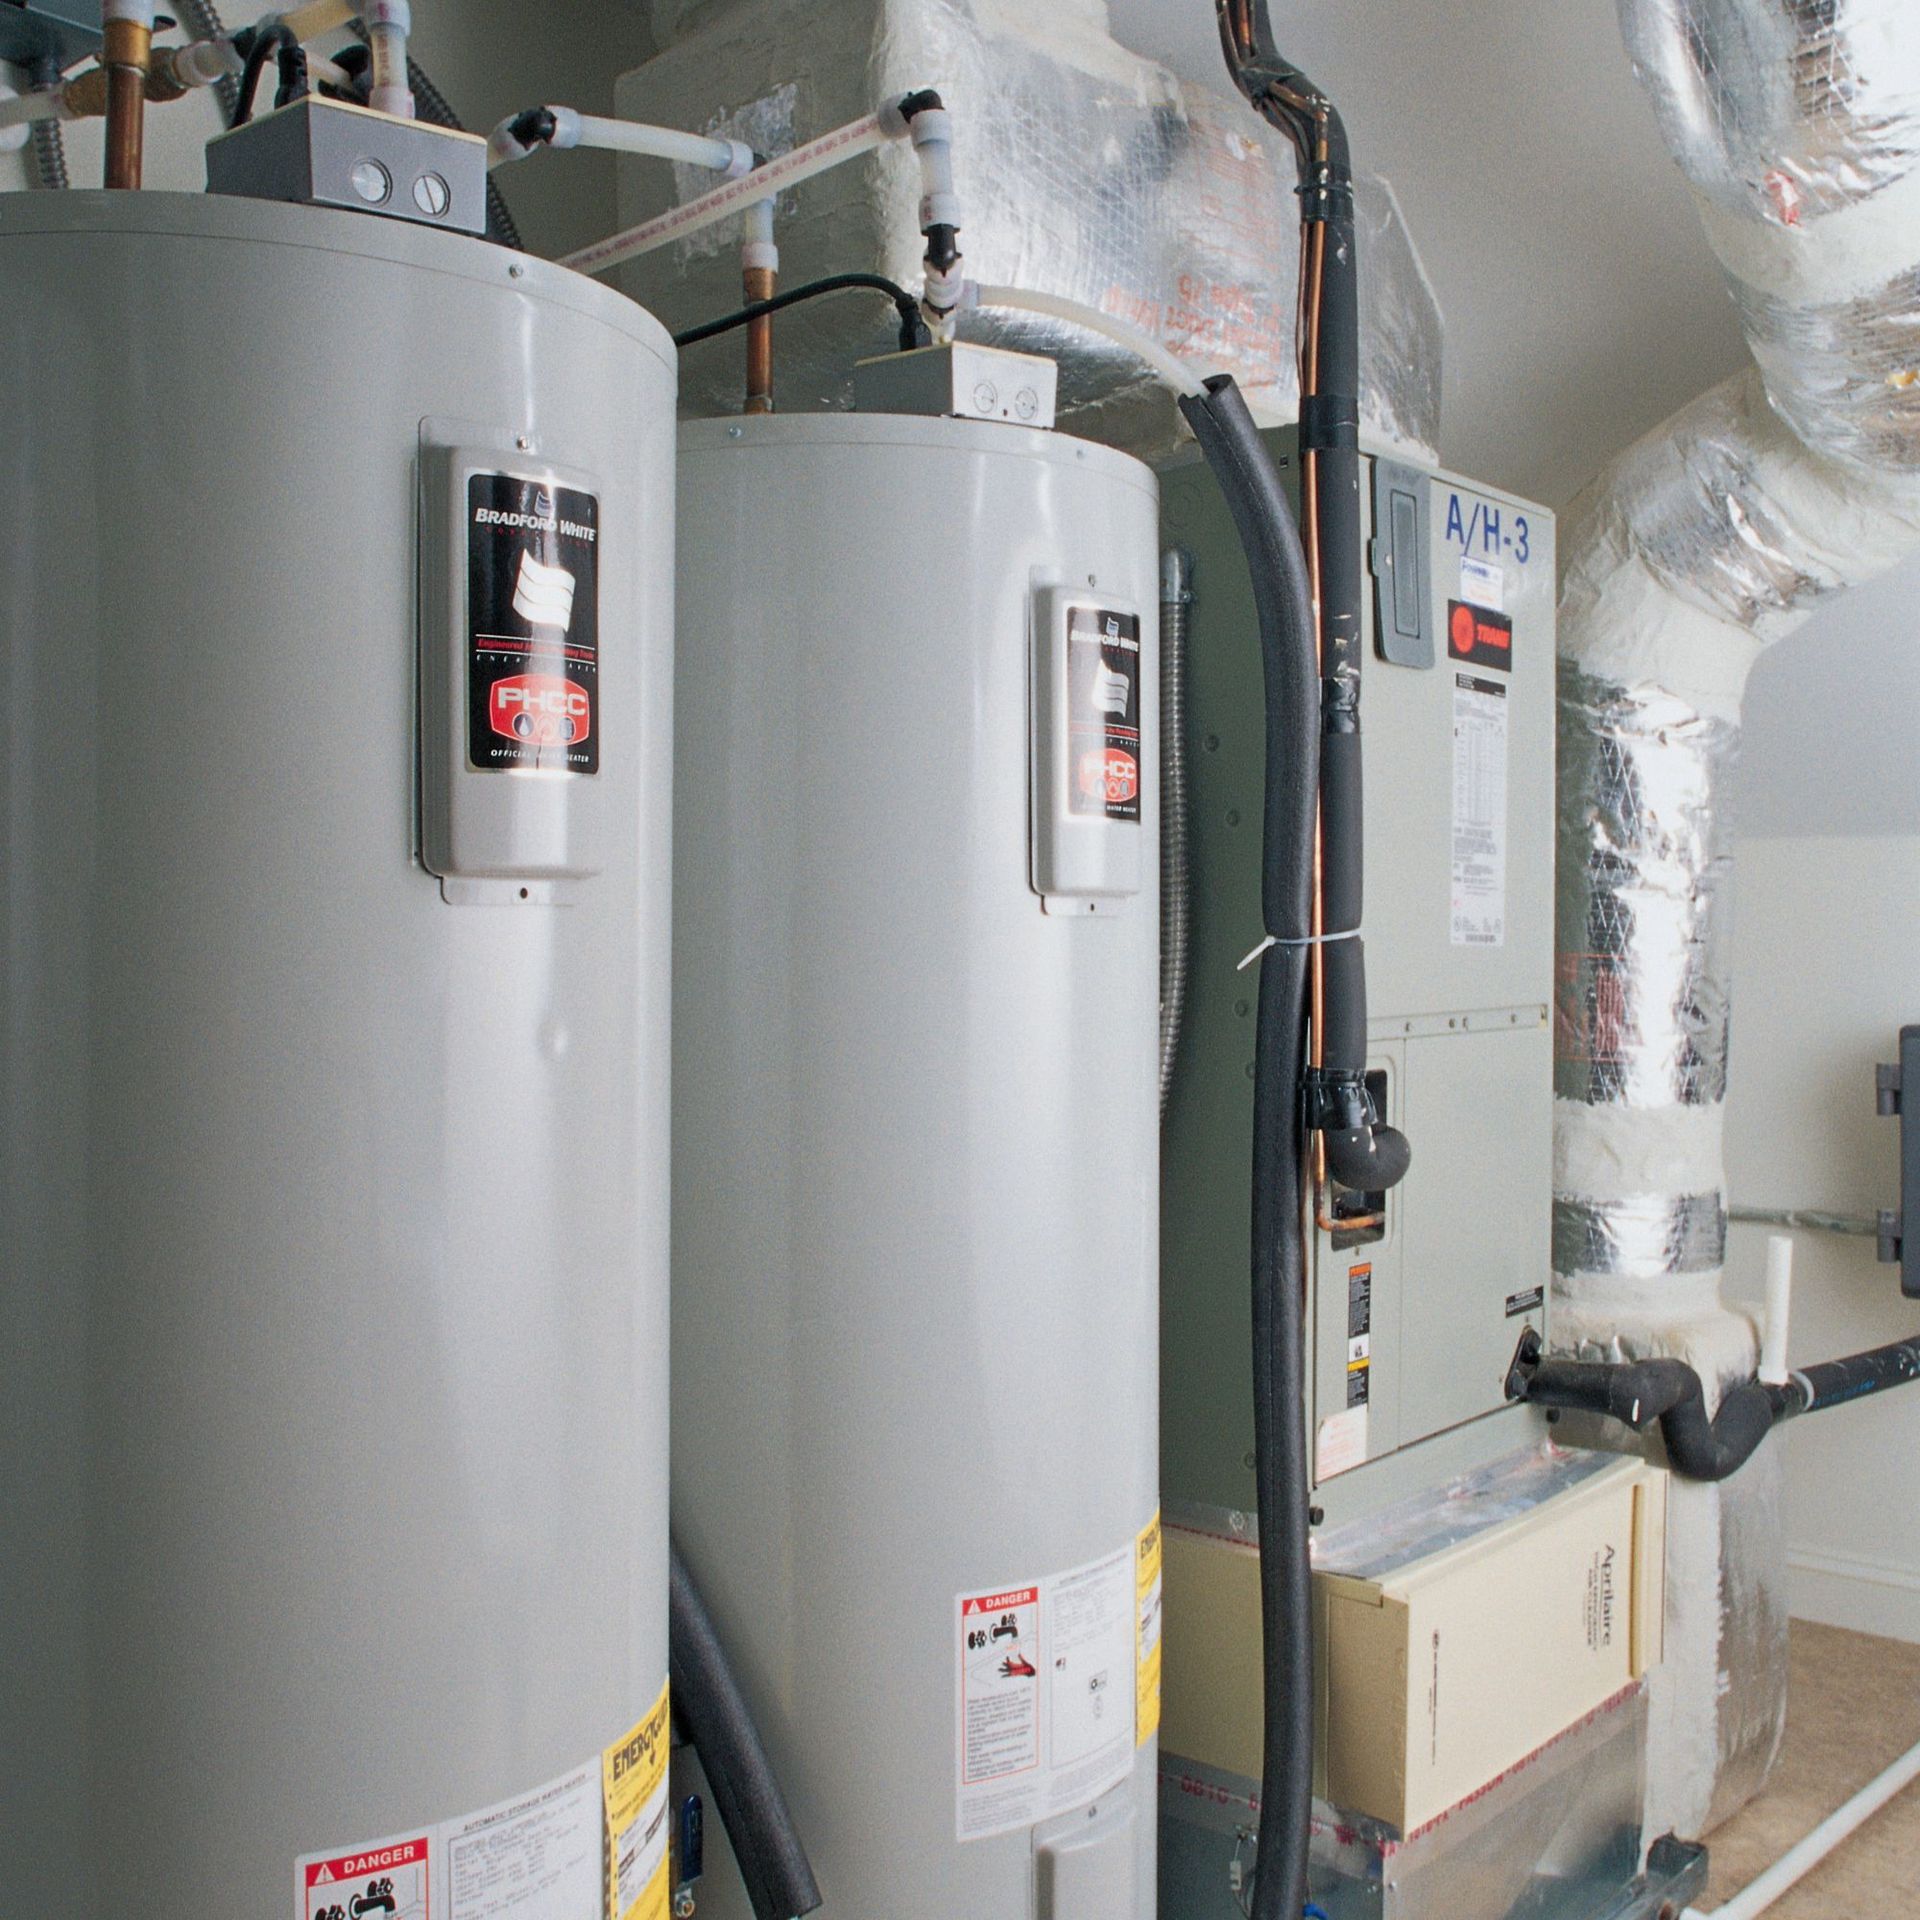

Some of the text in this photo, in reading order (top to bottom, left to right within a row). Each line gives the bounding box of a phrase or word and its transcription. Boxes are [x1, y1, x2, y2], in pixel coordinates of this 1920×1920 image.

[475, 507, 557, 532] BRADFORD
[560, 519, 597, 541] WHITE
[1446, 493, 1529, 563] A/H-3
[498, 687, 587, 716] PHCC
[985, 1592, 1031, 1610] DANGER
[1601, 1544, 1616, 1646] Aprilaire
[464, 1811, 506, 1832] AUTOMATIC
[343, 1846, 415, 1875] DANGER
